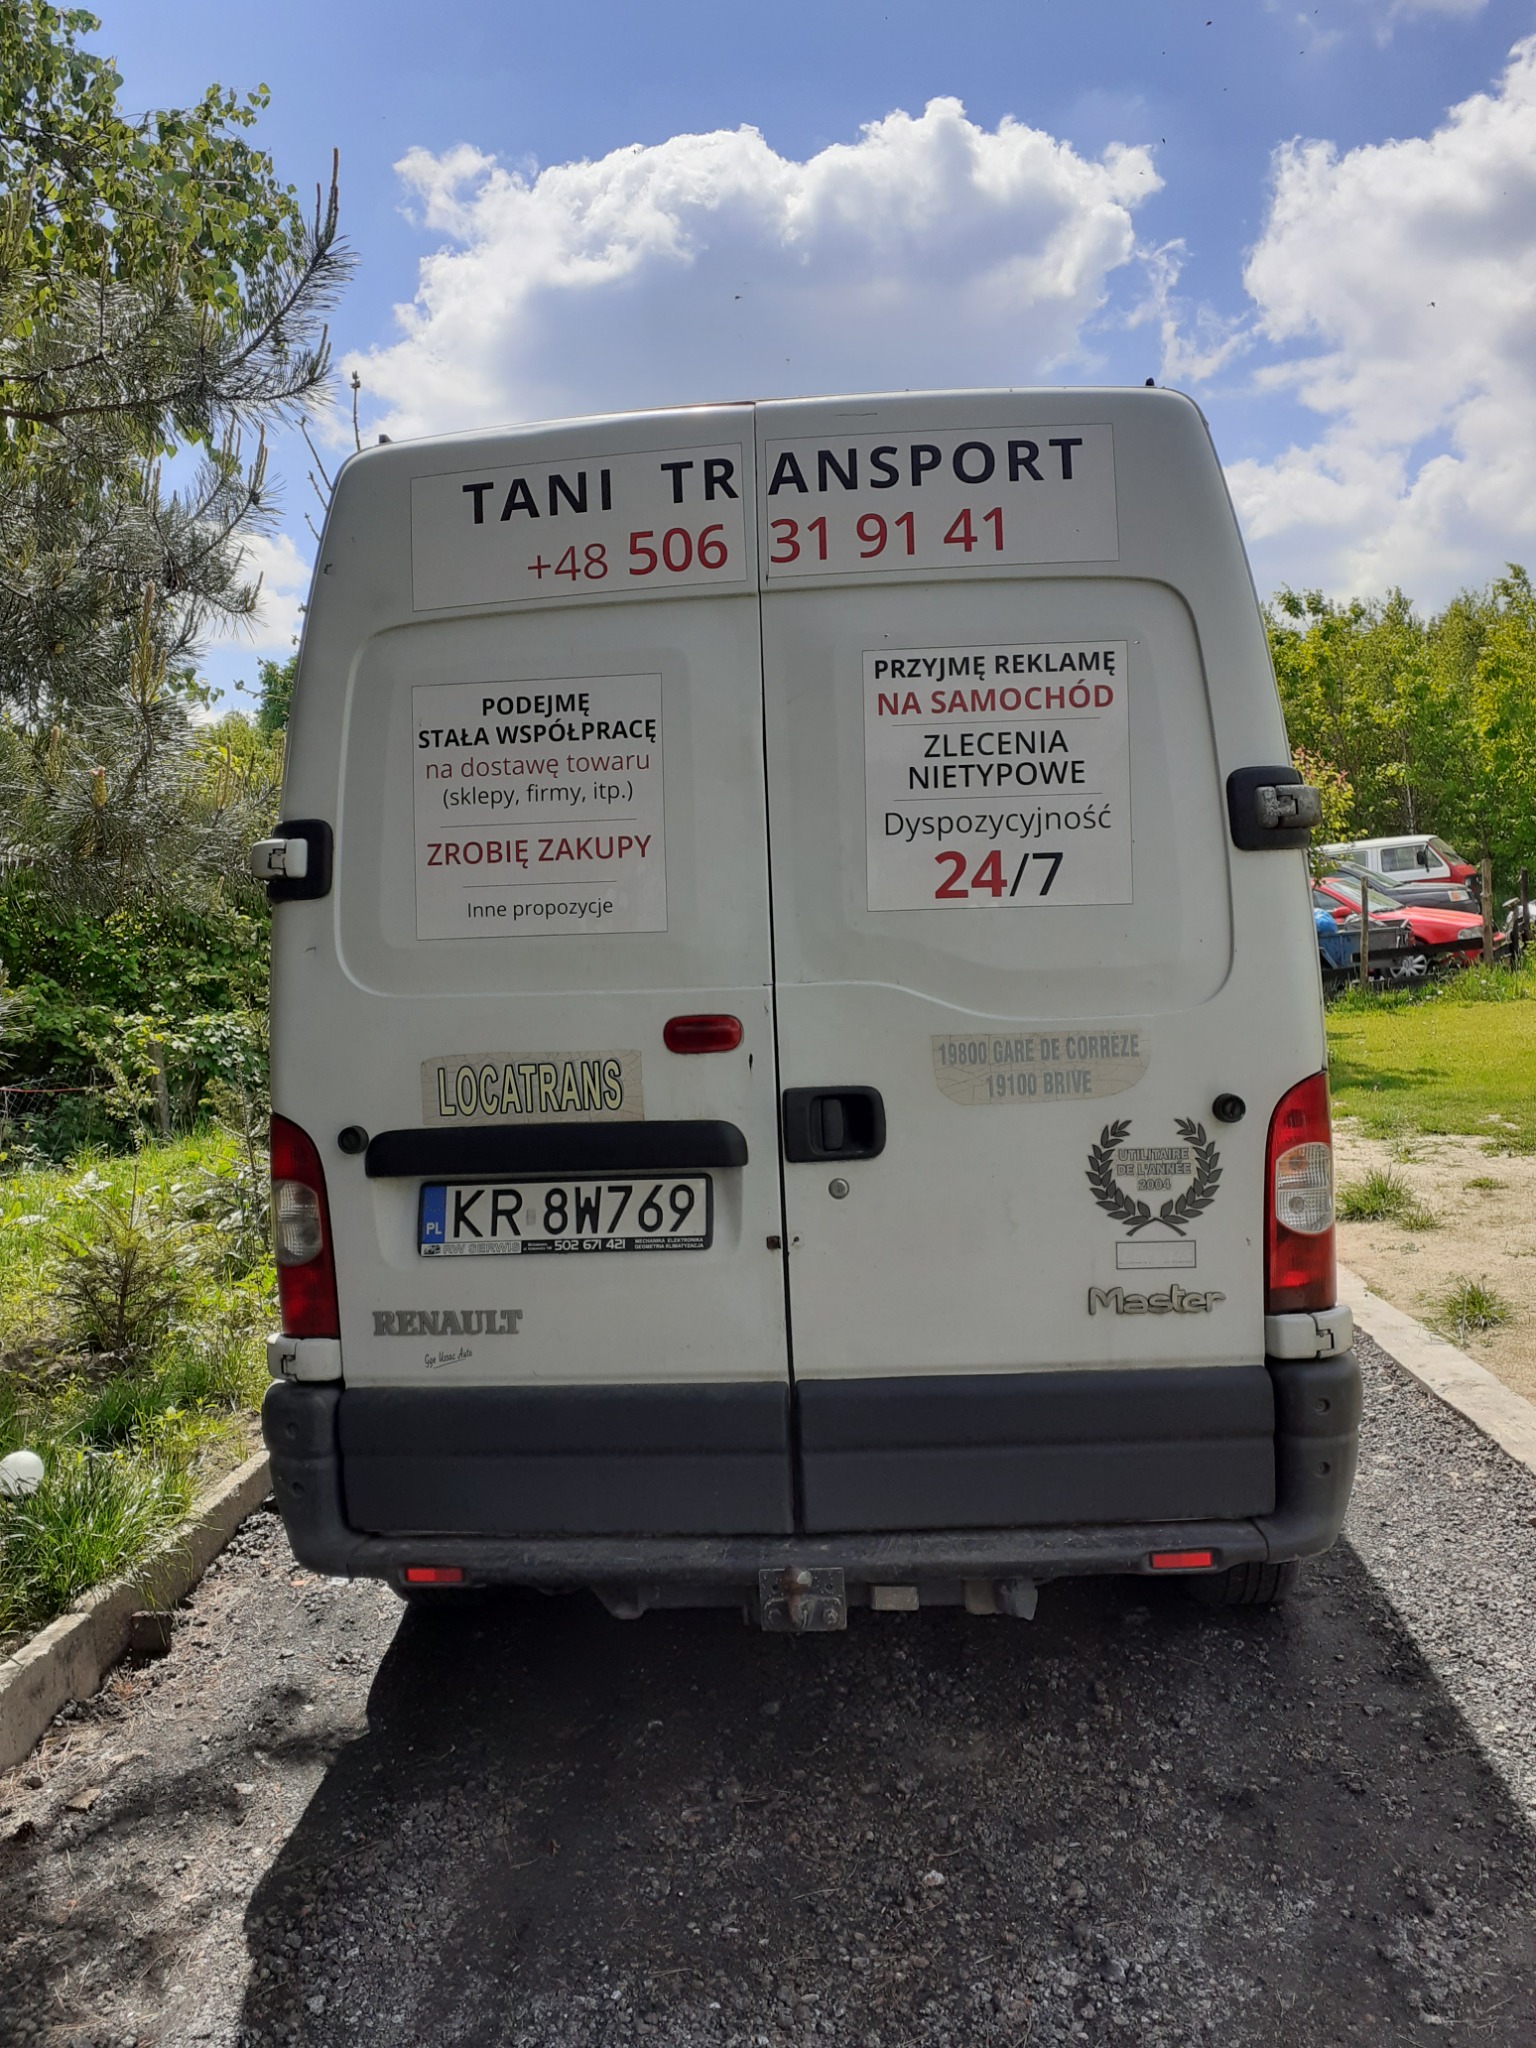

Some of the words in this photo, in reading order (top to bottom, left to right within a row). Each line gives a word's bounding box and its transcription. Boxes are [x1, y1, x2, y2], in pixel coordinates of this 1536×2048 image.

[462, 467, 613, 525] TANI
[527, 543, 609, 582] +48
[628, 523, 729, 576] 506
[769, 515, 828, 564] 31
[856, 510, 916, 559] 91
[943, 506, 1004, 553] 41
[874, 655, 986, 683] PRZYJMĘ
[994, 650, 1116, 677] REKLAMĘ
[481, 692, 590, 718] PODEJMĘ
[877, 691, 922, 717] NA
[930, 678, 1114, 714] SAMOCHÓD
[418, 727, 490, 749] STAŁA
[495, 718, 657, 744] WSPÓŁPRACĘ
[923, 729, 1070, 758] ZLECENIA
[425, 763, 453, 779] na
[460, 756, 559, 779] dostawę
[566, 753, 650, 774] towaru
[908, 760, 1086, 790] NIETYPOWE
[443, 786, 520, 810] (sklepy,
[526, 783, 586, 806] firmy,
[593, 780, 633, 804] itp.)
[884, 803, 1113, 843] Dyspozycyjność
[427, 839, 529, 869] ZROBIĘ
[538, 834, 652, 862] ZAKUPY
[934, 850, 1064, 900] 24/7
[467, 902, 507, 919] Inne
[512, 898, 614, 921] propozycje
[938, 1041, 988, 1066] 19800
[993, 1038, 1035, 1063] GARE
[1040, 1038, 1060, 1061] DE
[437, 1059, 623, 1117] LOCATRANS
[986, 1072, 1038, 1098] 19100
[1043, 1070, 1093, 1095] BRIVE
[1118, 1147, 1190, 1161] UTILITAIRE
[1116, 1163, 1134, 1176] DE
[1138, 1178, 1172, 1191] 2004
[453, 1189, 523, 1238] KR
[543, 1183, 696, 1235] 8W769
[426, 1222, 443, 1235] PL
[468, 1241, 520, 1253] SERWIS
[554, 1240, 579, 1251] 502
[582, 1239, 602, 1250] 671
[605, 1238, 626, 1249] 421
[1088, 1283, 1227, 1316] Master
[372, 1309, 523, 1337] RENAULT
